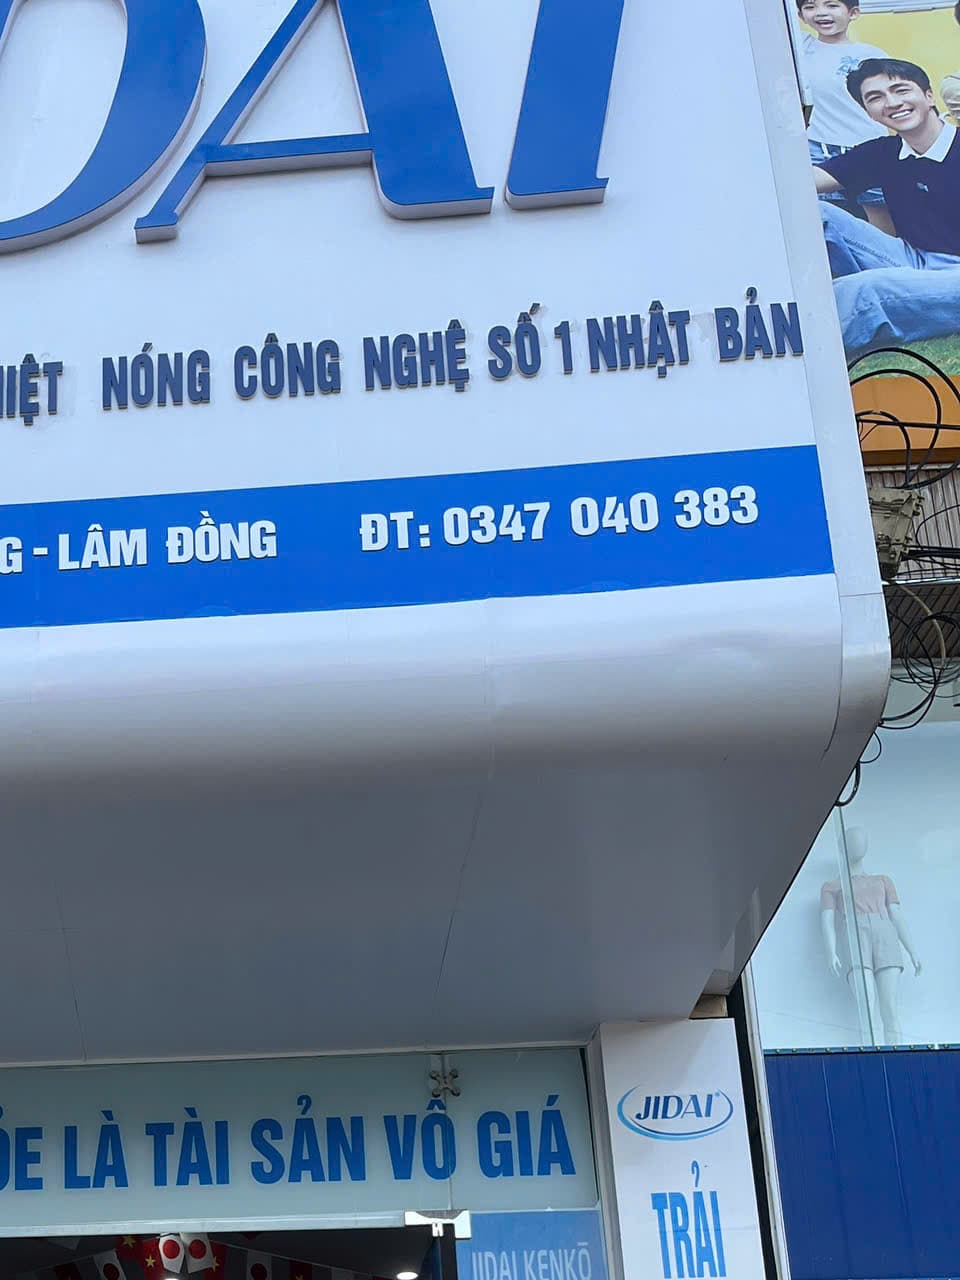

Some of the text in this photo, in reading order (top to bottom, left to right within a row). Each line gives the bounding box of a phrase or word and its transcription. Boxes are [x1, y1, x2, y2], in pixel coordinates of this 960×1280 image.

[101, 342, 211, 411] NÓNG
[233, 332, 343, 398] CÔNG
[363, 319, 471, 392] NGHỆ
[487, 303, 543, 382] SỐ
[553, 319, 575, 375] 1
[587, 300, 692, 379] NHẬT
[715, 287, 804, 362] BẢN
[58, 520, 148, 571] LÂM
[165, 511, 278, 565] ĐỒNG
[360, 485, 759, 552] ĐT: 0347 040 383
[63, 1110, 129, 1190] LÀ
[145, 1107, 230, 1188] TÀI
[251, 1094, 365, 1184] SẢN
[383, 1097, 457, 1181] VÔ
[476, 1094, 576, 1179] GIÁ
[634, 1092, 715, 1121] JIDAI
[651, 1160, 727, 1279] TRẢI
